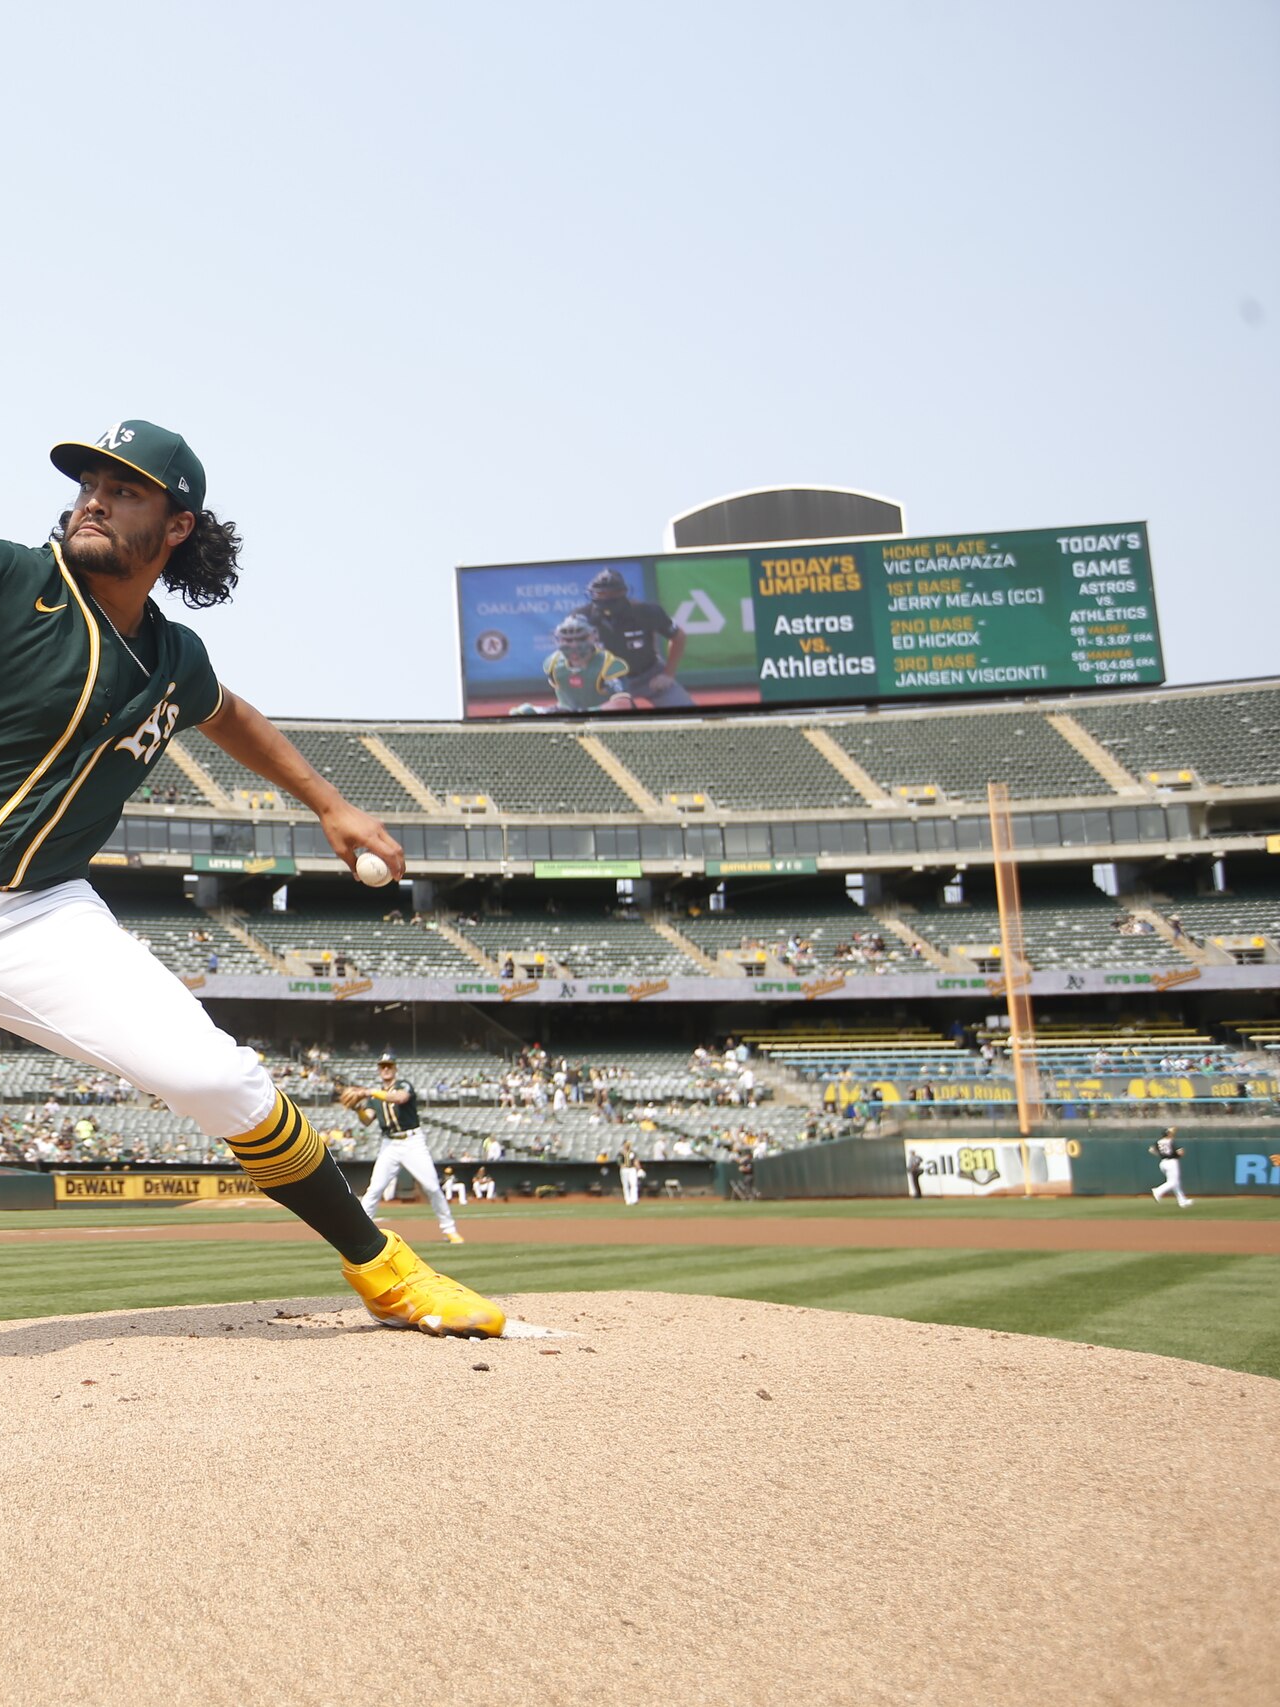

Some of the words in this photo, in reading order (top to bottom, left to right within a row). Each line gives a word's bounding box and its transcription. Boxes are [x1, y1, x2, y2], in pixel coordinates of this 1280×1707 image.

[95, 422, 136, 450] A's
[882, 543, 930, 560] HOME
[935, 540, 987, 556] PLATE
[1057, 533, 1141, 554] TODAY'S
[762, 555, 855, 577] TODAY'S
[883, 559, 912, 576] VIC
[914, 553, 1017, 574] CARAPAZZA
[1072, 558, 1131, 578] GAME
[759, 572, 862, 596] UMPIRES
[887, 581, 914, 597] 1ST
[918, 578, 961, 594] BASE
[1079, 580, 1136, 595] ASTROS
[477, 601, 549, 616] OAKLAND
[888, 594, 941, 612] JERRY
[946, 590, 1003, 608] MEALS
[1069, 606, 1148, 623] ATHLETICS
[773, 614, 854, 636] Astros
[891, 618, 926, 635] 2ND
[929, 615, 975, 632] BASE
[892, 634, 915, 650] ED
[919, 631, 981, 649] HICKOX
[1133, 633, 1154, 642] ERA
[760, 653, 876, 680] Athletics
[894, 656, 929, 672] 3RD
[932, 653, 977, 670] BASE
[1136, 657, 1156, 667] ERA
[895, 669, 964, 687] JANSEN
[967, 664, 1048, 684] VISCONTI
[1120, 671, 1139, 682] PM
[114, 682, 180, 765] A's
[957, 1147, 995, 1174] 811
